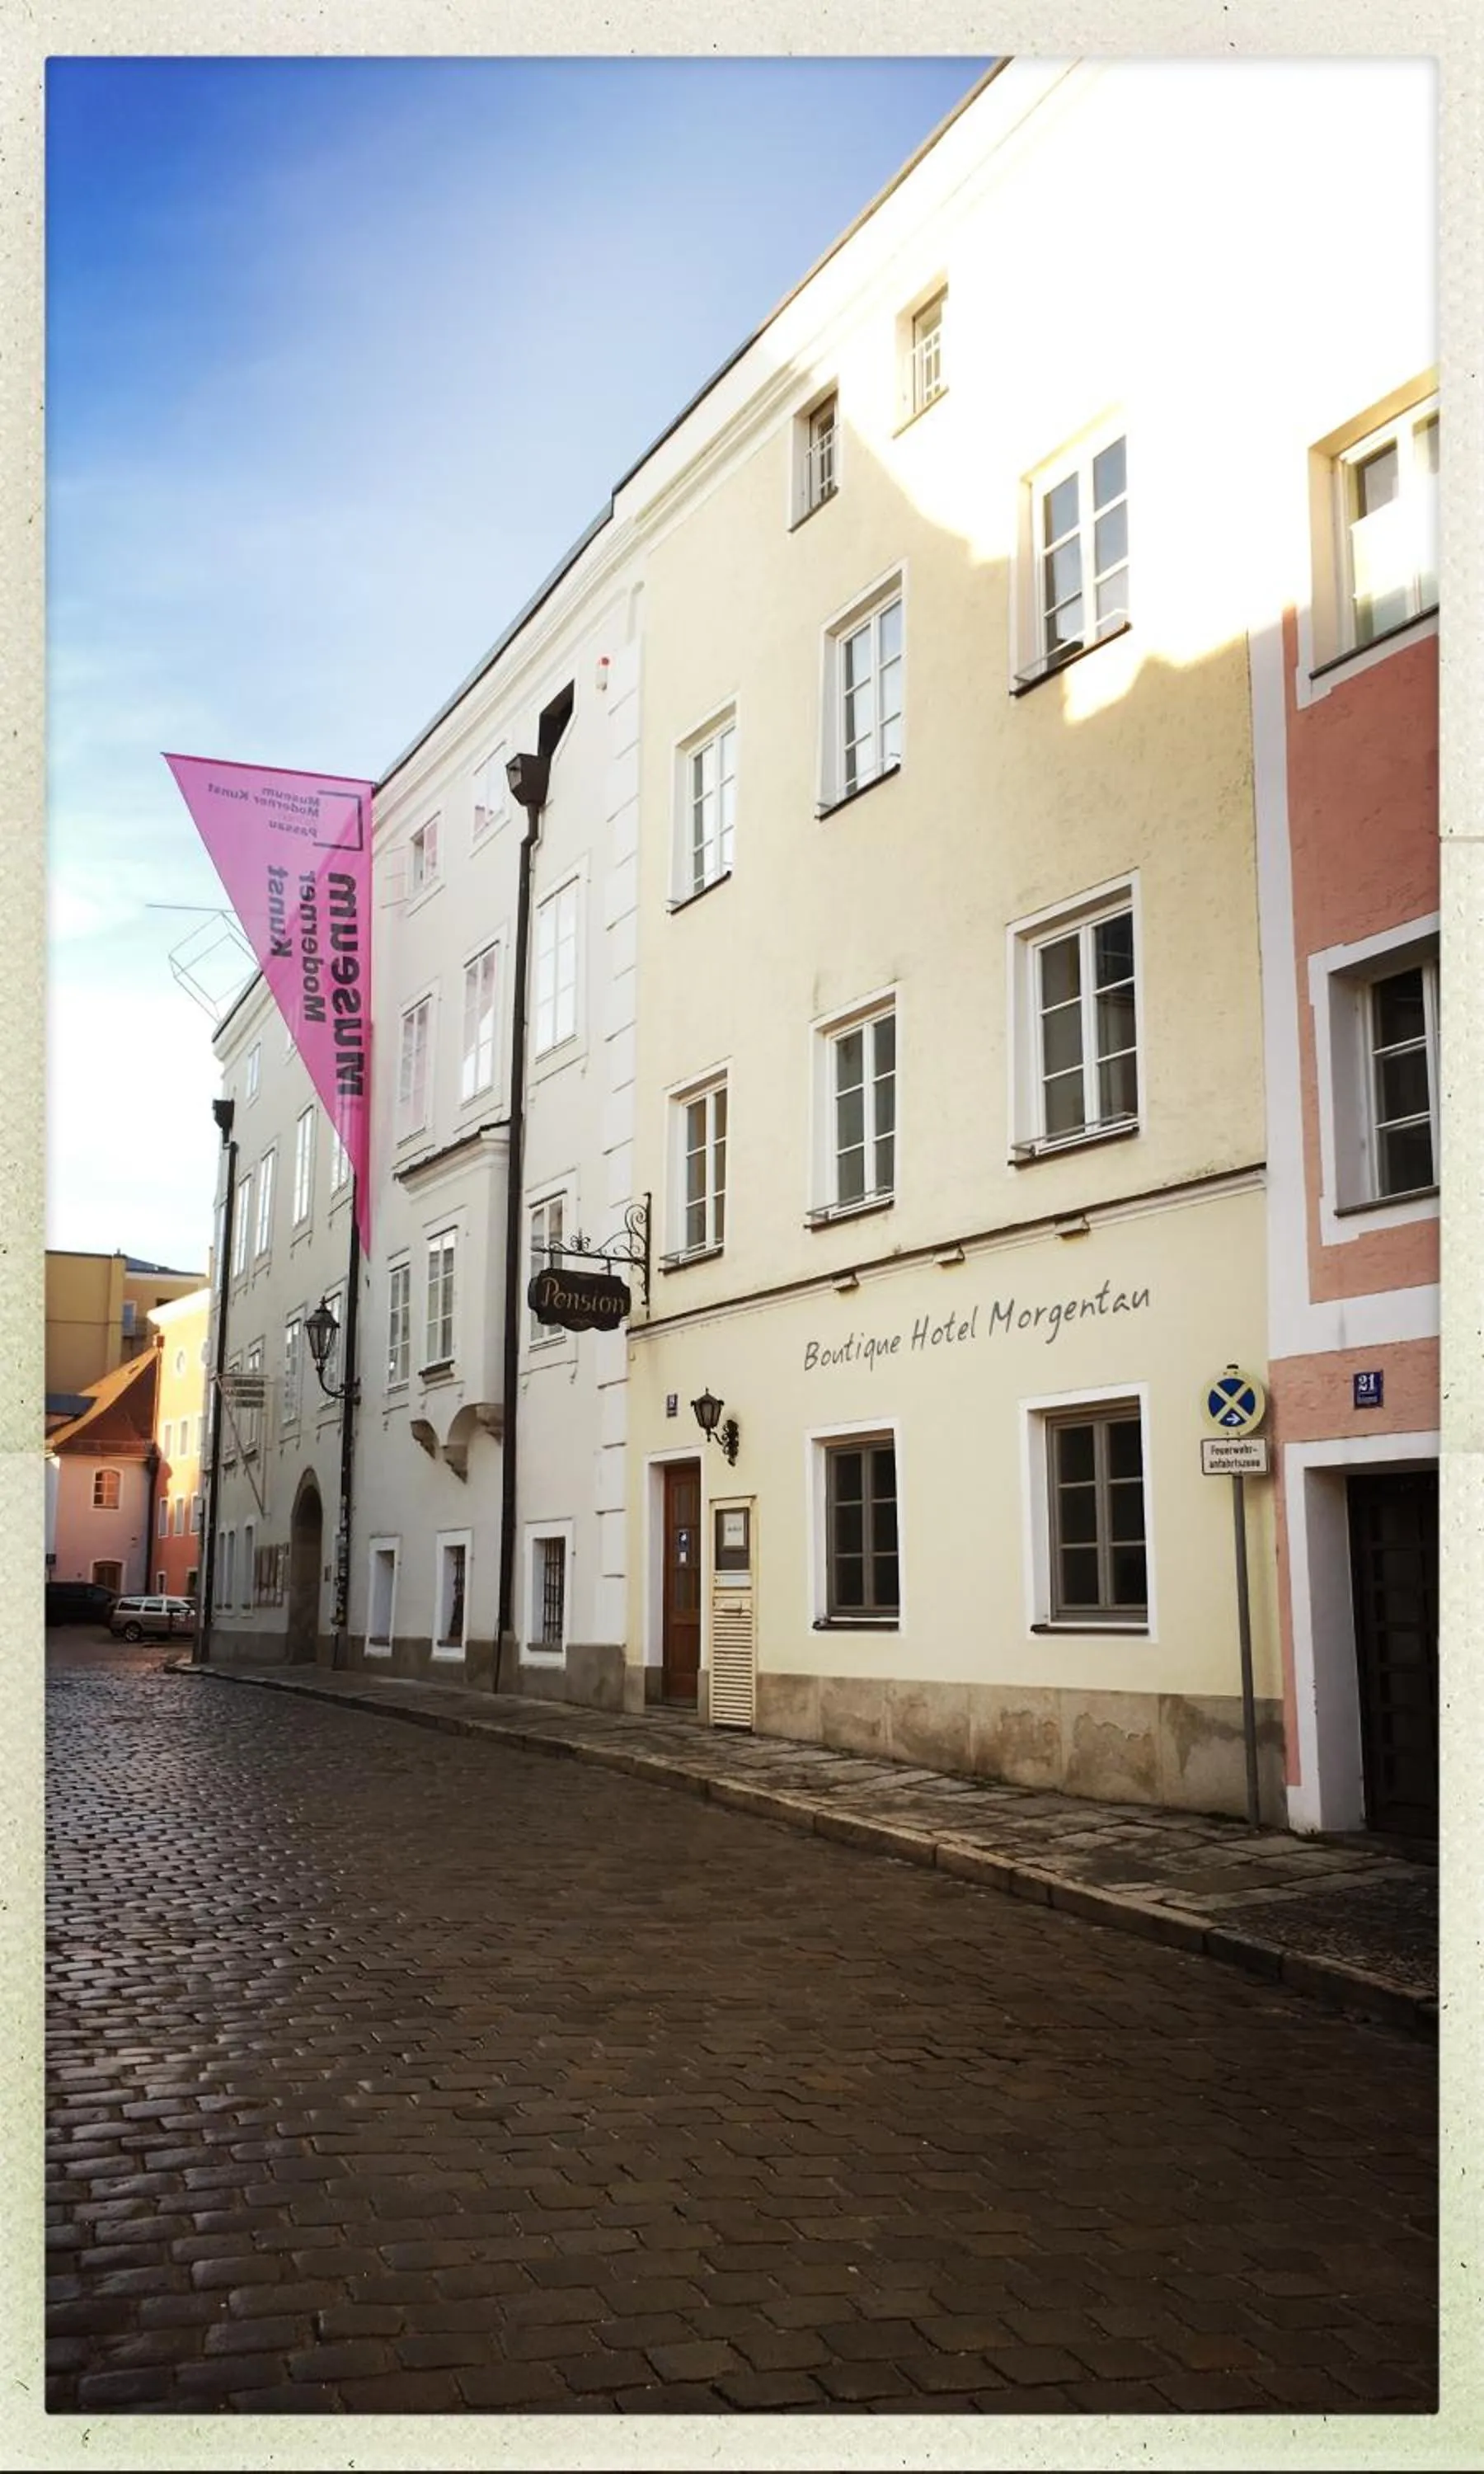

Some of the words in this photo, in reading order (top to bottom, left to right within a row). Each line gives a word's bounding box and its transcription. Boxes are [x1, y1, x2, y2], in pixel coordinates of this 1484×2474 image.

[541, 1276, 624, 1314] Pension
[804, 1332, 901, 1371] Boutique
[911, 1305, 977, 1351] Hotel
[989, 1279, 1151, 1345] Morgentau
[1358, 1373, 1374, 1391] 21
[1210, 1444, 1257, 1456] Feuerwehr-
